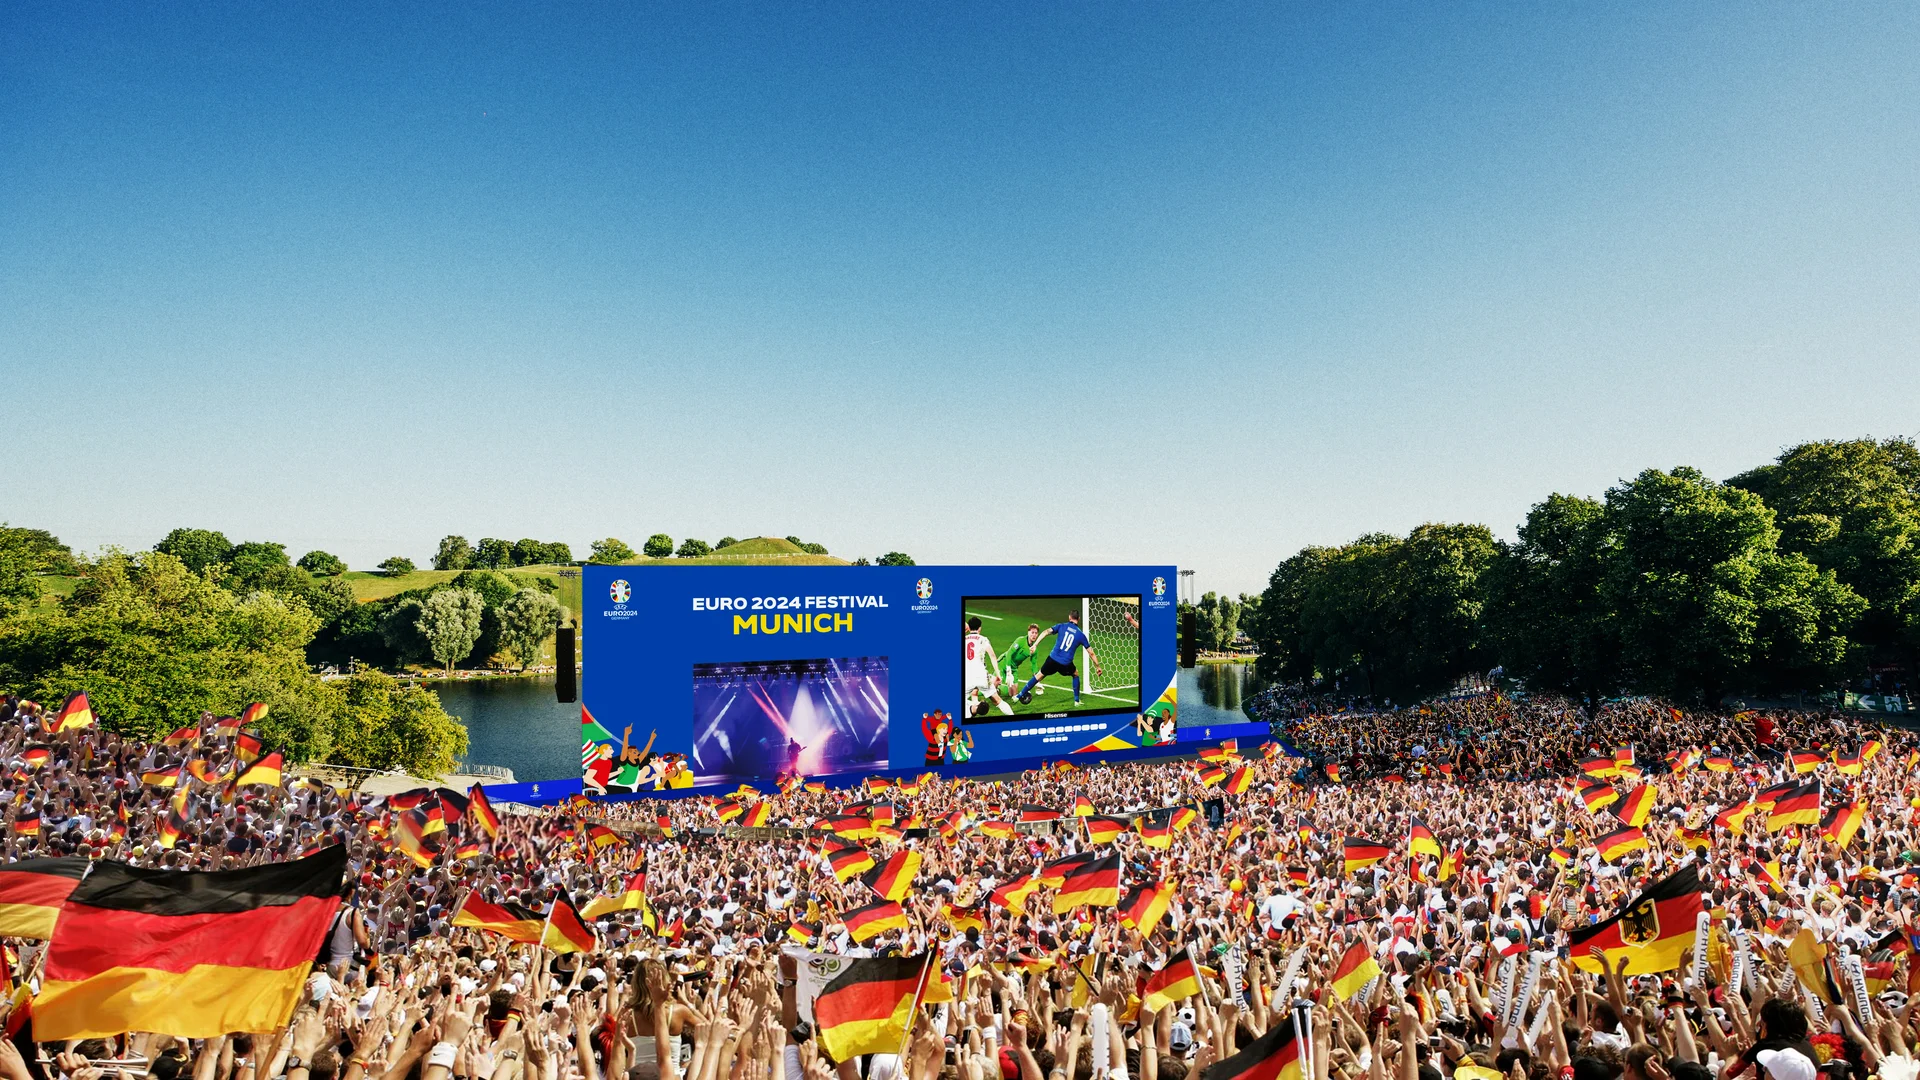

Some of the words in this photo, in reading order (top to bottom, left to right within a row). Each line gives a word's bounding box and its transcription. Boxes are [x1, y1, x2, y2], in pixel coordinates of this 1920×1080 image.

[692, 597, 748, 611] EURO
[751, 596, 801, 610] 2024
[804, 595, 889, 609] FESTIVAL
[733, 612, 853, 635] MUNICH
[966, 641, 975, 661] 6
[1060, 630, 1075, 652] 19
